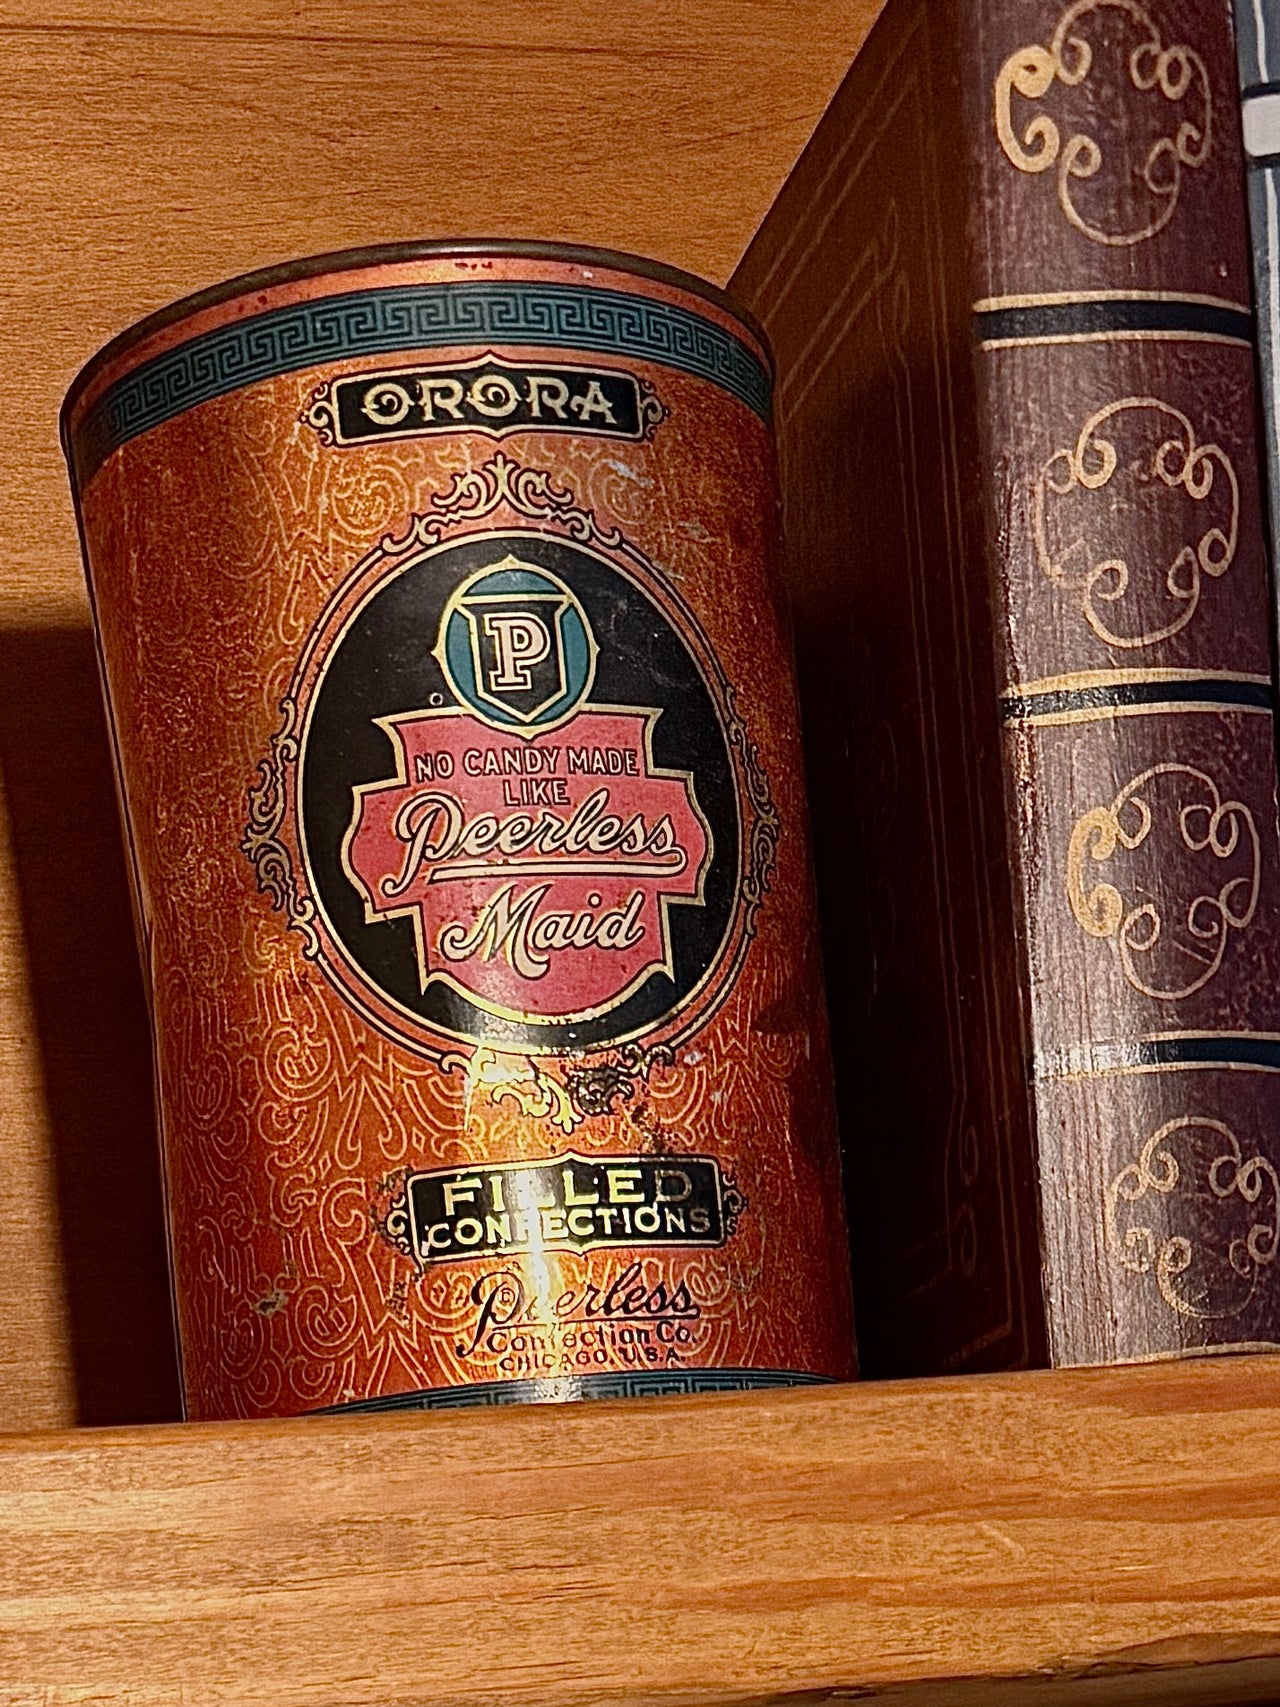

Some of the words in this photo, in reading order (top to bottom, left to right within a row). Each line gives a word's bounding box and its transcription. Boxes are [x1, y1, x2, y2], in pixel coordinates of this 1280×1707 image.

[361, 374, 617, 426] ORORA
[484, 612, 550, 691] P
[415, 752, 455, 783] NO
[462, 746, 561, 778] CANDY
[568, 747, 640, 777] MADE
[502, 780, 570, 806] LIKE
[381, 788, 687, 897] Peerless
[440, 881, 647, 980] Maid
[656, 1320, 697, 1343] Co.
